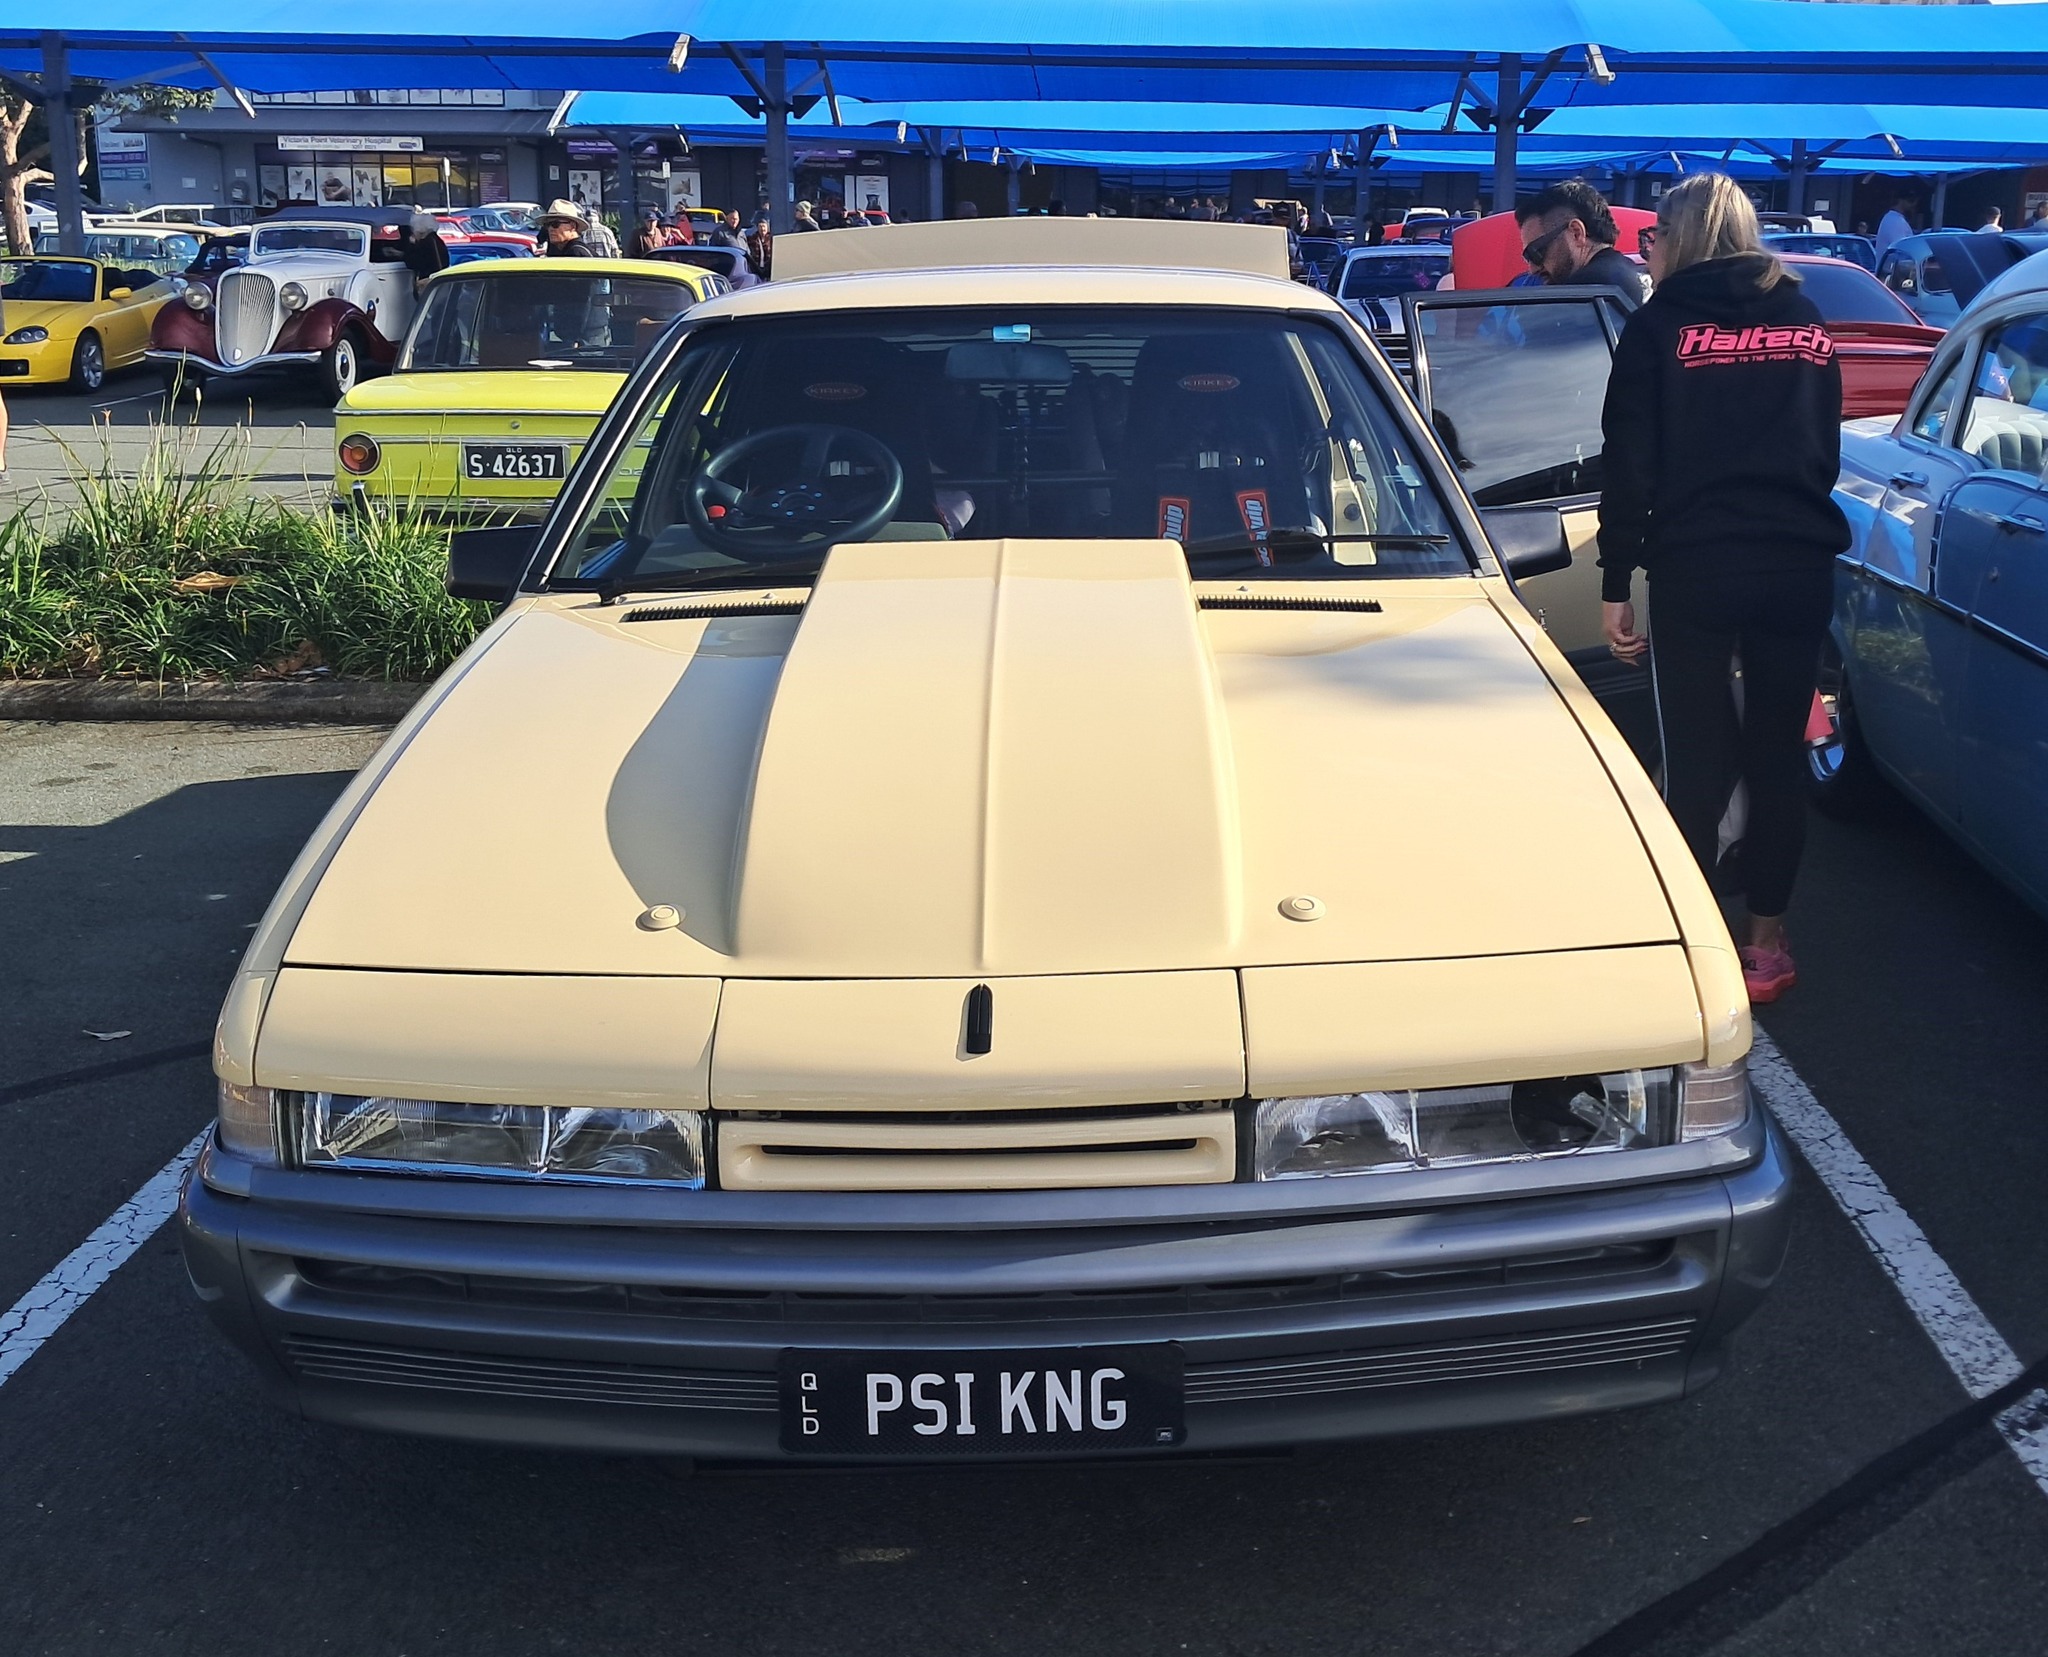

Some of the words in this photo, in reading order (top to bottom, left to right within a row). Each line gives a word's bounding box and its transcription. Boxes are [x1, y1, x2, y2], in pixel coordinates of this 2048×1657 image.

[328, 137, 362, 145] Veterinary
[364, 137, 393, 145] Hospital
[1680, 326, 1832, 356] Haltech
[866, 1373, 976, 1436] PSI
[1000, 1367, 1127, 1434] KNG
